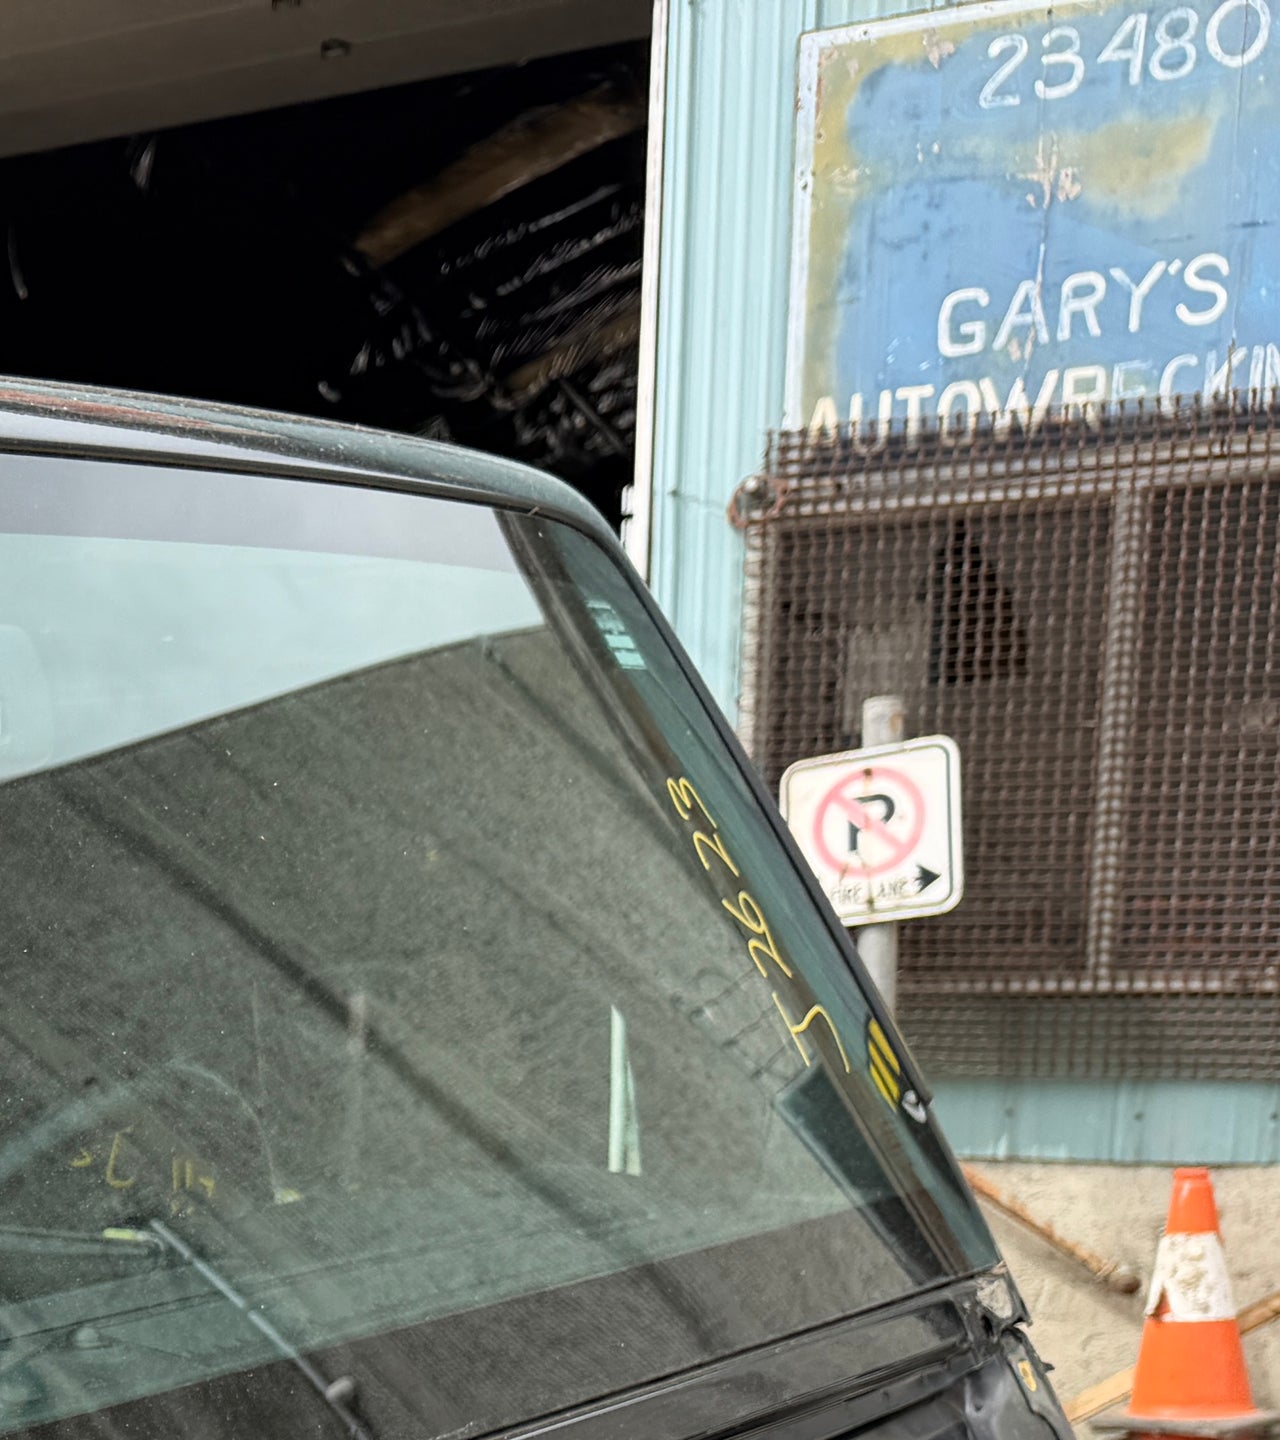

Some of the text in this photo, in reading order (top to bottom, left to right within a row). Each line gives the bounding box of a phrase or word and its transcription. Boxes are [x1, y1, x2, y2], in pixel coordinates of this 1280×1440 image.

[979, 0, 1272, 108] 23480
[938, 252, 1230, 358] GARY'S
[665, 776, 851, 1075] J2623
